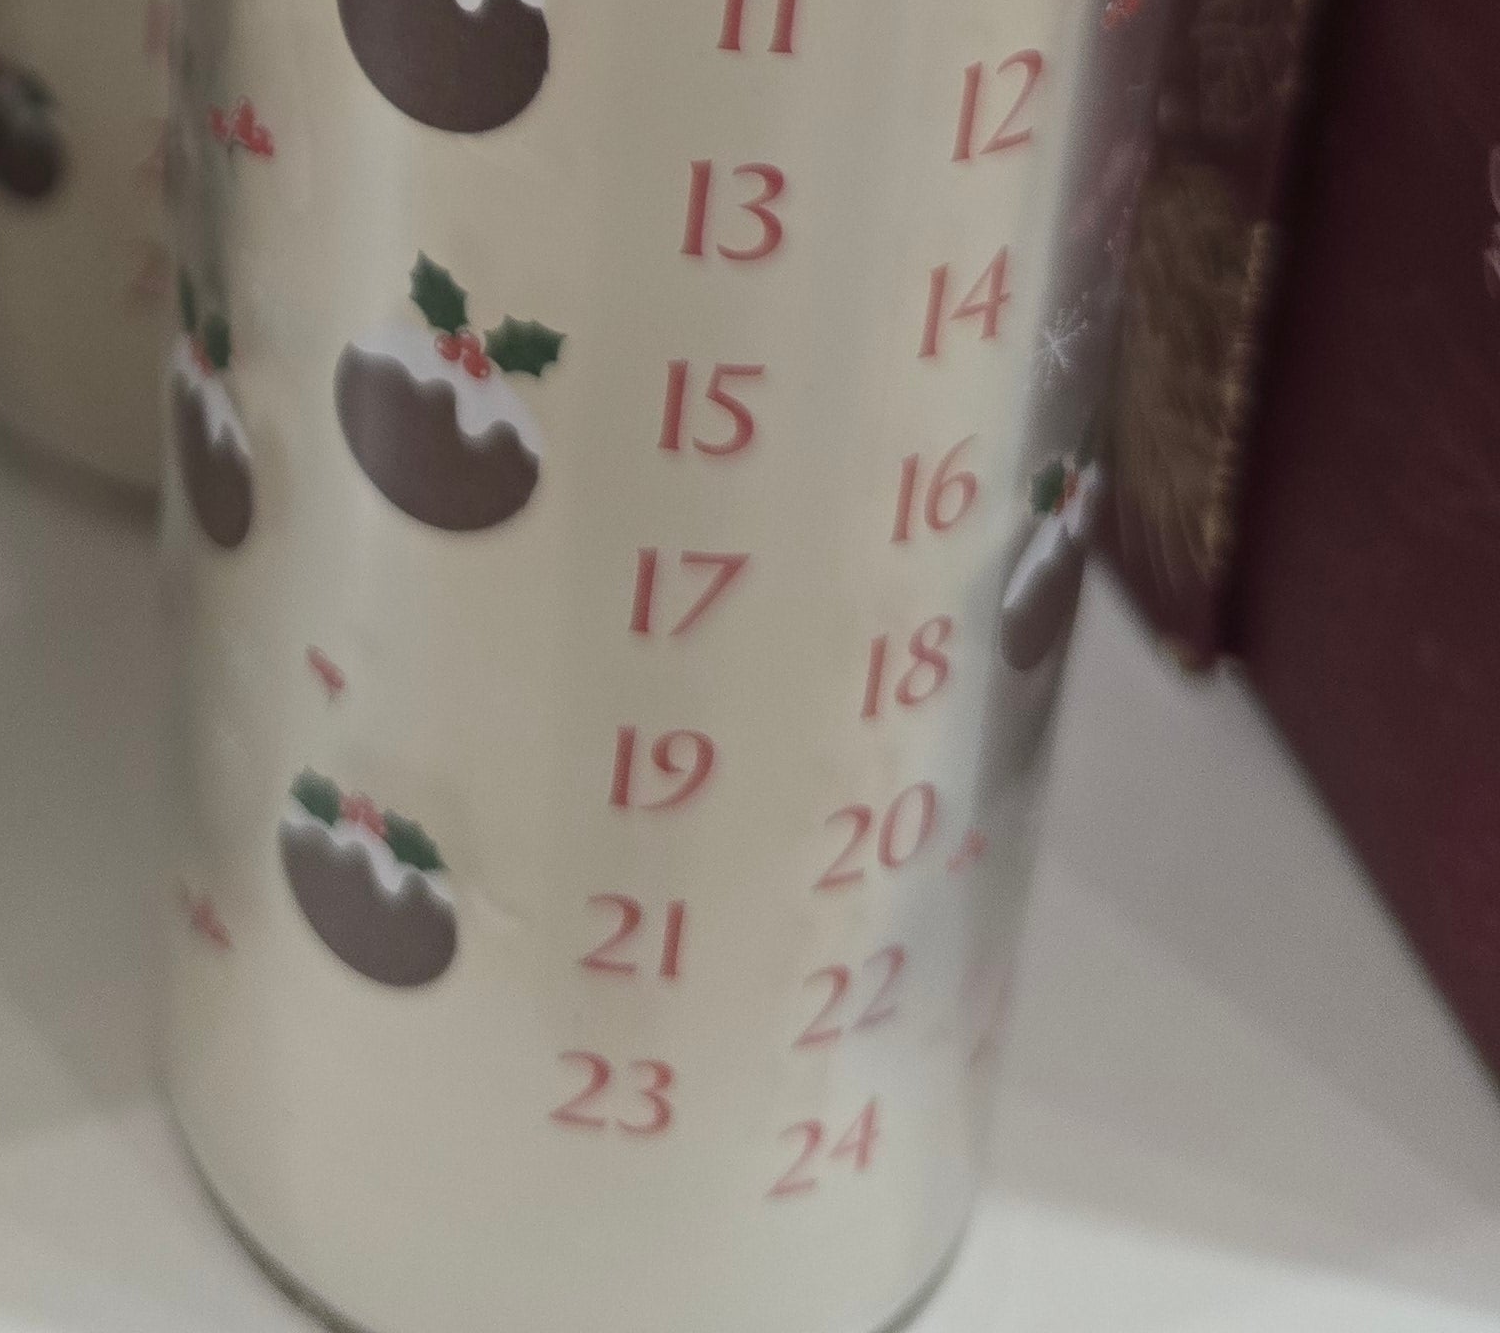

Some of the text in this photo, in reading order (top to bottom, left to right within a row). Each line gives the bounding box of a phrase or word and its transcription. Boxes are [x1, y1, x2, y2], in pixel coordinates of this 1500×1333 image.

[952, 49, 1045, 163] 12
[680, 160, 786, 260] 13
[918, 247, 1012, 358] 14
[657, 360, 764, 455] 15
[891, 435, 980, 544] 16
[629, 548, 749, 637] 17
[860, 616, 954, 721] 18
[609, 725, 717, 810] 19
[813, 782, 937, 891] 20
[577, 894, 687, 981] 21
[791, 943, 907, 1049] 22
[549, 1051, 676, 1136] 23
[766, 1098, 881, 1198] 24
